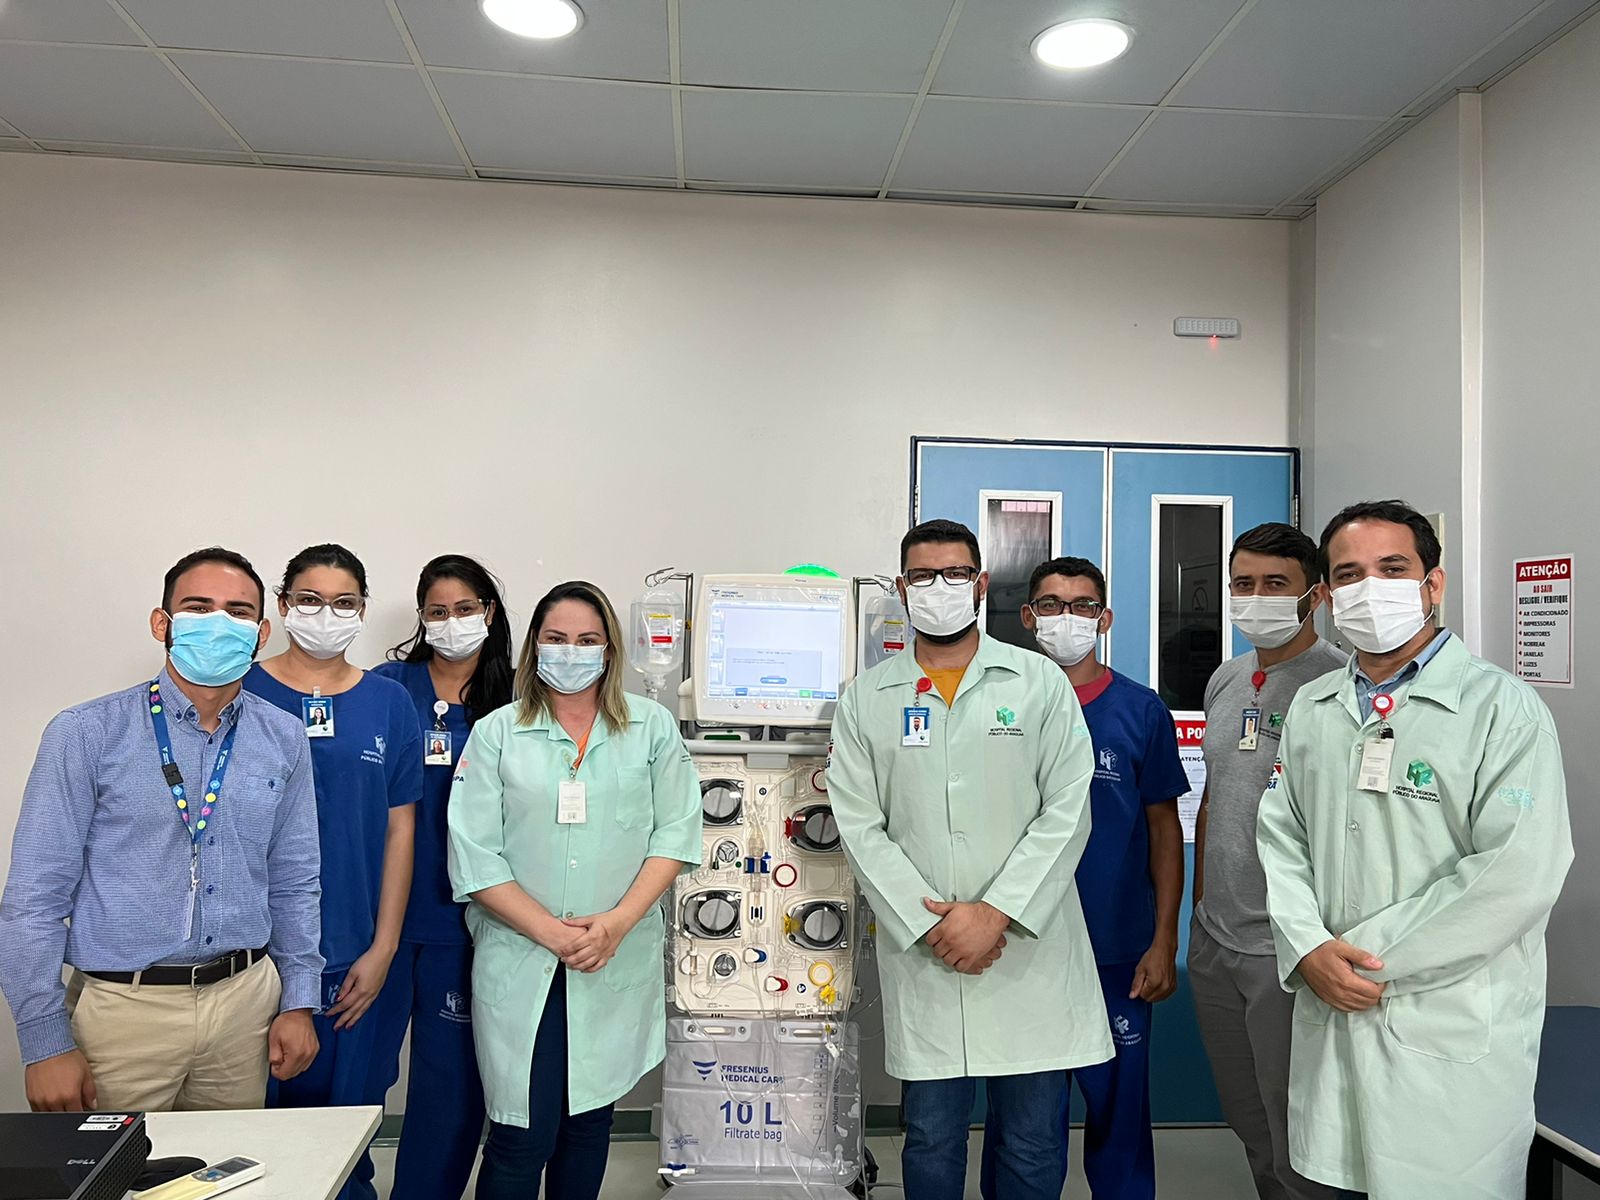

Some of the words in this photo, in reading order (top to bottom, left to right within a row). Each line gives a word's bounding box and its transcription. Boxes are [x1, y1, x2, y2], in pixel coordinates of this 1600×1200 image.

[1519, 561, 1568, 578] ATENÇÃO
[1543, 594, 1568, 604] VERIFIQUE
[720, 1064, 769, 1074] FRESENIUS
[721, 1074, 759, 1083] MEDICAL
[719, 1100, 753, 1125] 10
[765, 1102, 783, 1125] L
[832, 1095, 840, 1126] Volume
[724, 1127, 760, 1139] Filtrate
[763, 1128, 783, 1142] bag
